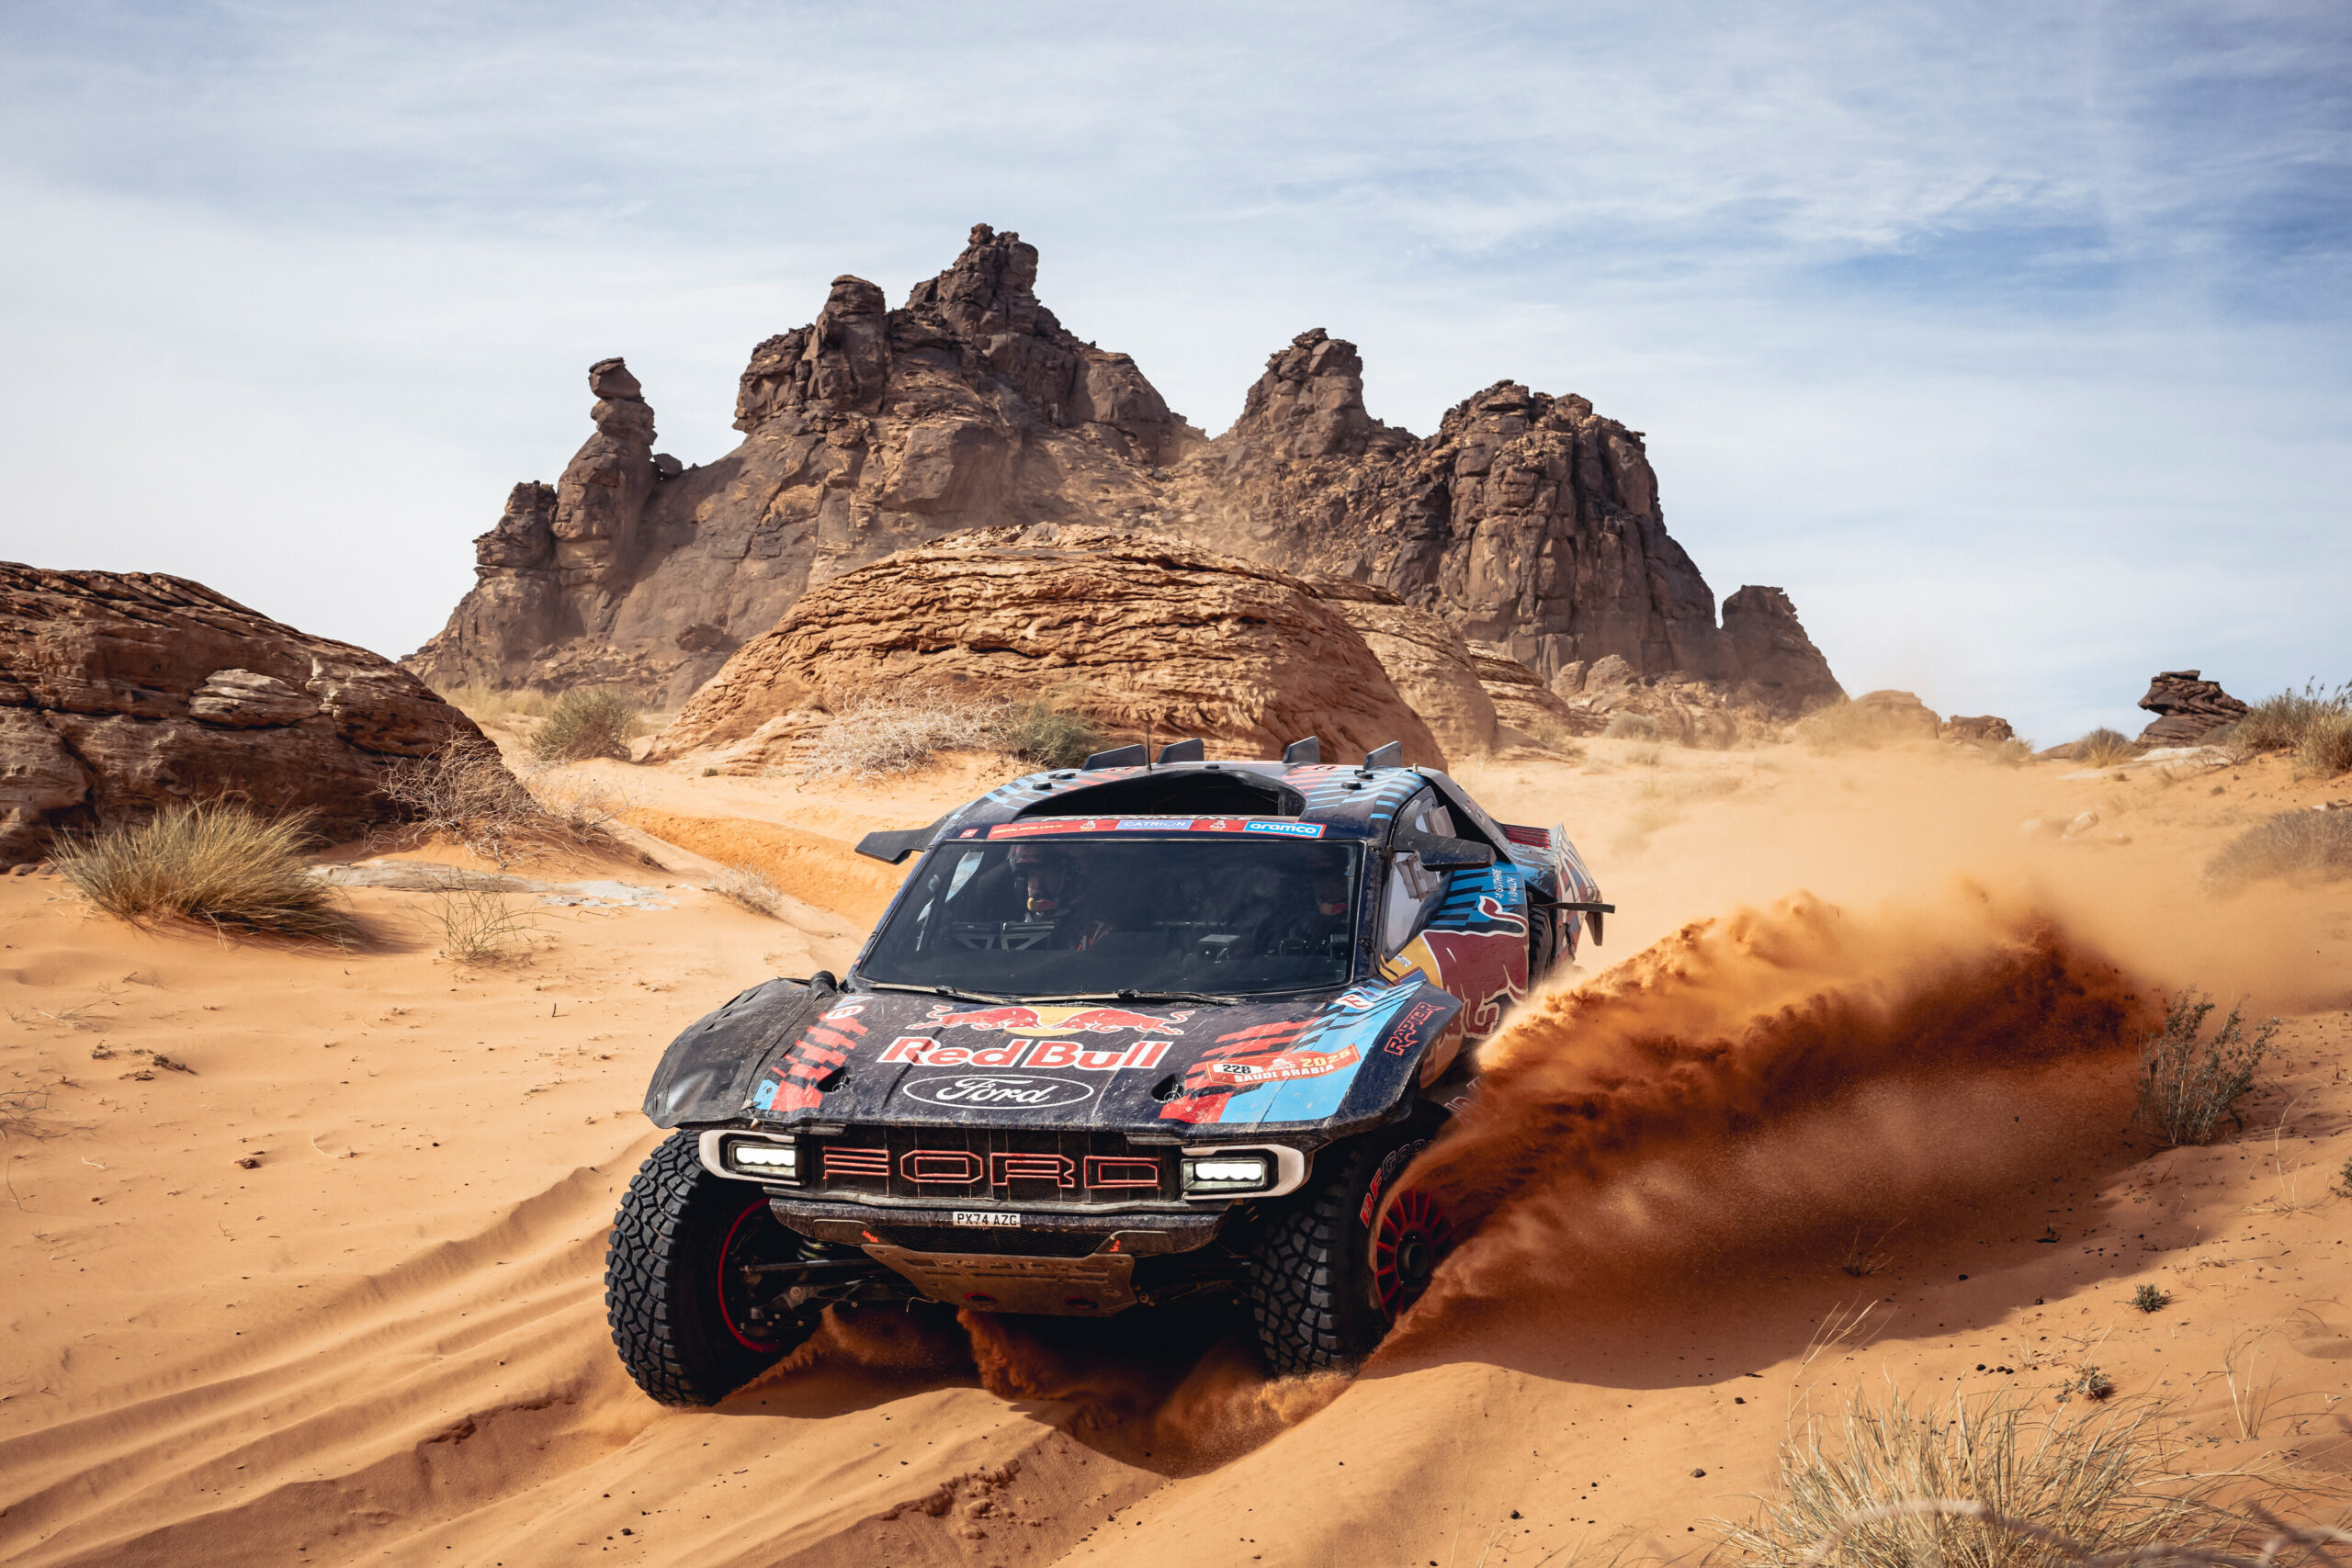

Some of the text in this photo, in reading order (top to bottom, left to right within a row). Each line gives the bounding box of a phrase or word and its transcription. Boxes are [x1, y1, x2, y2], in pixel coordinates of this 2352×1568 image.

[1250, 823, 1317, 834] aramco
[1384, 1001, 1447, 1056] RAPTOR
[876, 1036, 1173, 1070] Red Bull
[1300, 1050, 1351, 1068] 2025
[1223, 1064, 1251, 1075] 228
[1234, 1072, 1277, 1083] SAUDI
[1281, 1064, 1335, 1077] ARABIA
[935, 1077, 1059, 1103] Ford
[957, 1213, 1017, 1226] PX74 AZG
